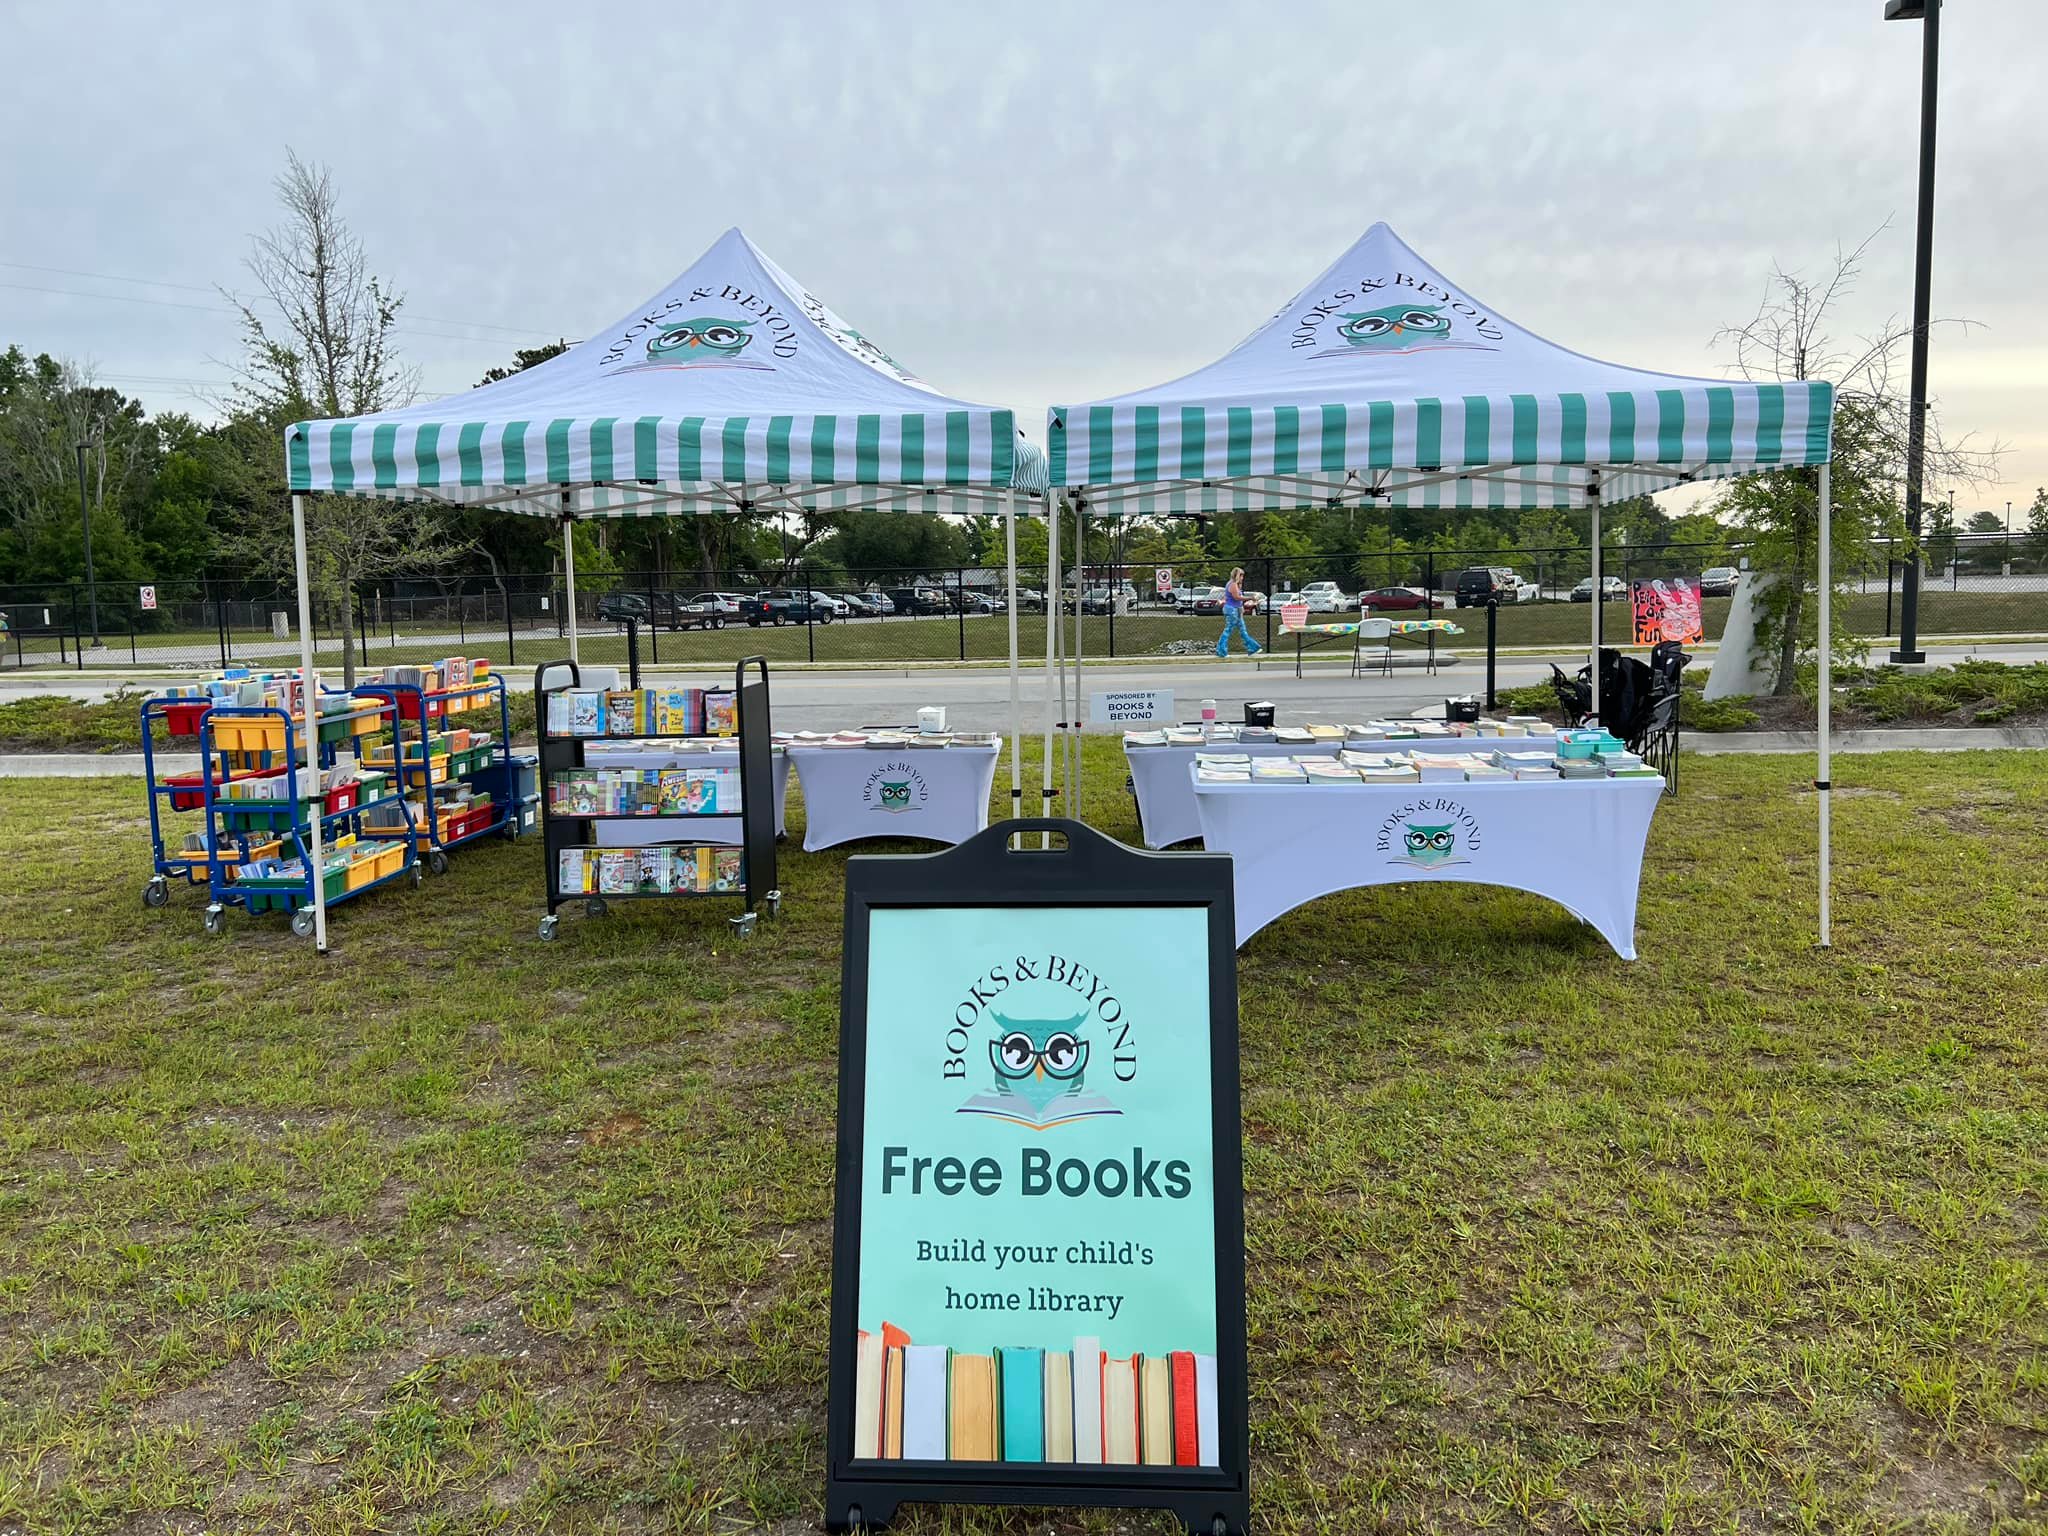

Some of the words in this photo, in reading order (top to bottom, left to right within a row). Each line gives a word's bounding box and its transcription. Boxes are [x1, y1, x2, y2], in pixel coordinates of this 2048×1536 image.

[600, 298, 683, 365] BOOKS
[690, 287, 714, 302] &
[720, 284, 798, 358] BEYOND
[1291, 289, 1356, 350] BOOKS
[1361, 277, 1387, 294] &
[1394, 272, 1503, 342] BEYOND
[1108, 702, 1144, 711] BOOKS
[1147, 702, 1154, 710] &
[1110, 711, 1152, 720] BEYOND
[863, 766, 886, 801] BOOKS
[887, 763, 896, 772] &
[898, 762, 928, 801] BEYOND
[1377, 803, 1415, 851] BOOKS
[1418, 799, 1431, 810] &
[1435, 798, 1480, 851] BEYOND
[943, 965, 1010, 1081] BOOKS
[1015, 955, 1040, 982] &
[1045, 955, 1137, 1082] BEYOND
[881, 1146, 1003, 1196] Free
[1021, 1147, 1192, 1199] Books
[916, 1238, 986, 1263] Build
[993, 1244, 1058, 1270] your
[1065, 1241, 1154, 1266] child's
[944, 1286, 1020, 1311] home
[1028, 1287, 1124, 1320] library
